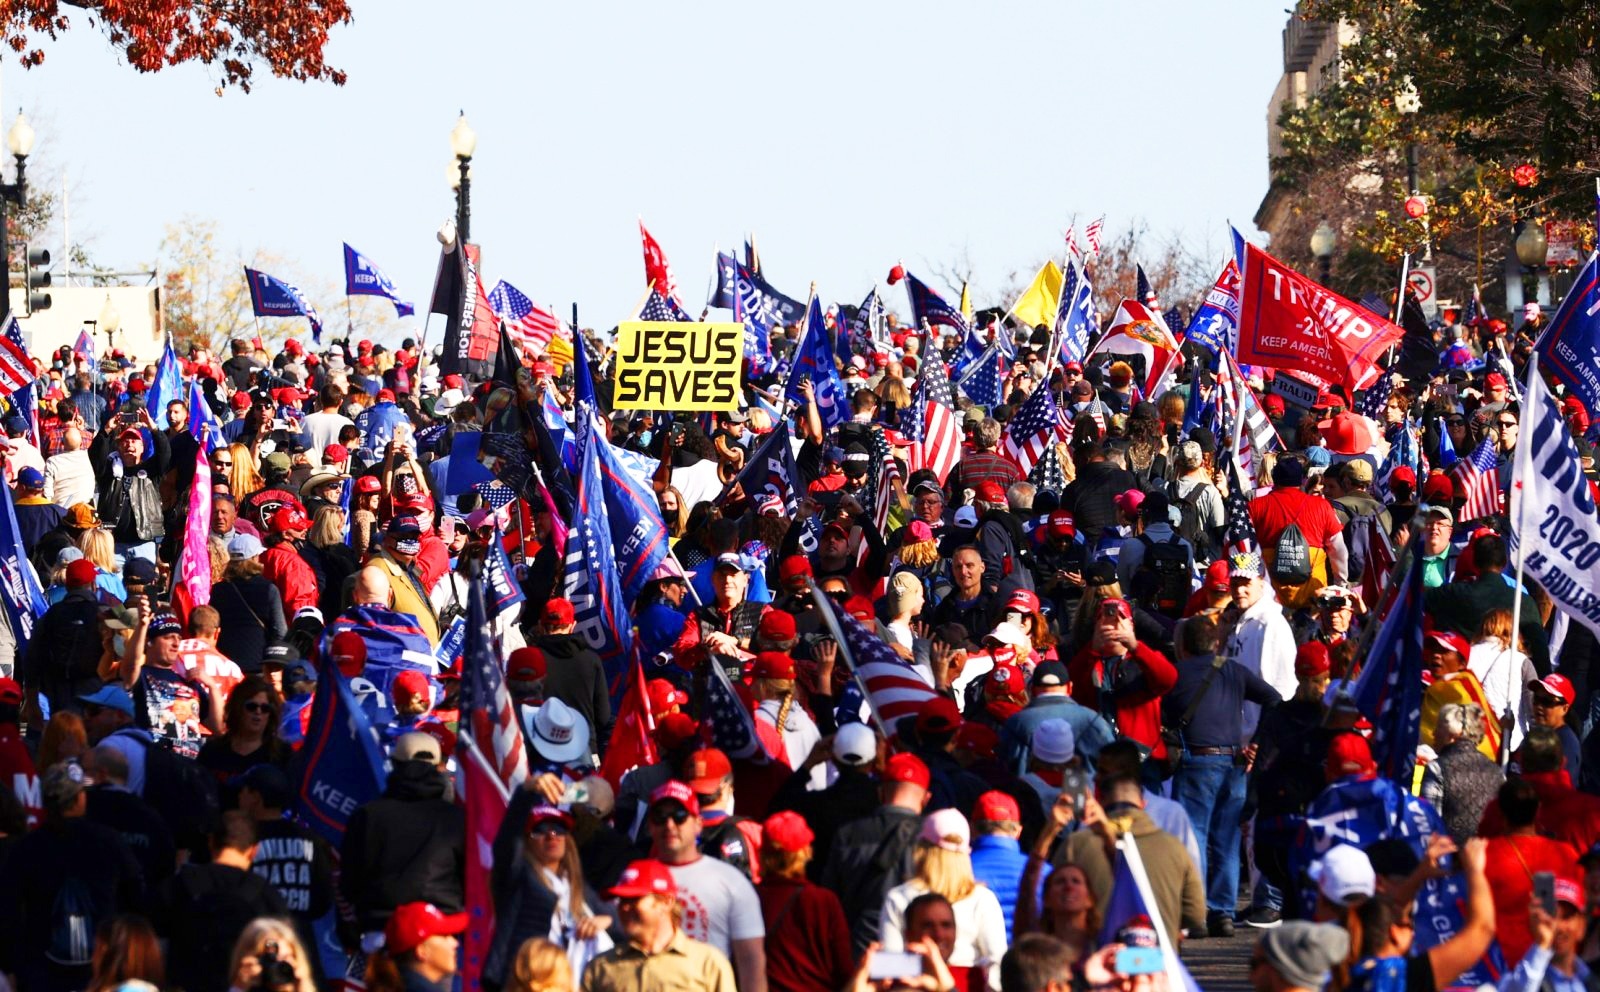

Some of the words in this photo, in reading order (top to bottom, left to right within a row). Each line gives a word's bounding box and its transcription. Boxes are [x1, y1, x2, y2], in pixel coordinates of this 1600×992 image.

[622, 327, 738, 365] JESUS
[1261, 335, 1288, 348] KEEP
[1555, 339, 1577, 363] KEEP
[617, 369, 737, 407] SAVES
[1539, 503, 1600, 571] 2020
[312, 780, 358, 816] KEE
